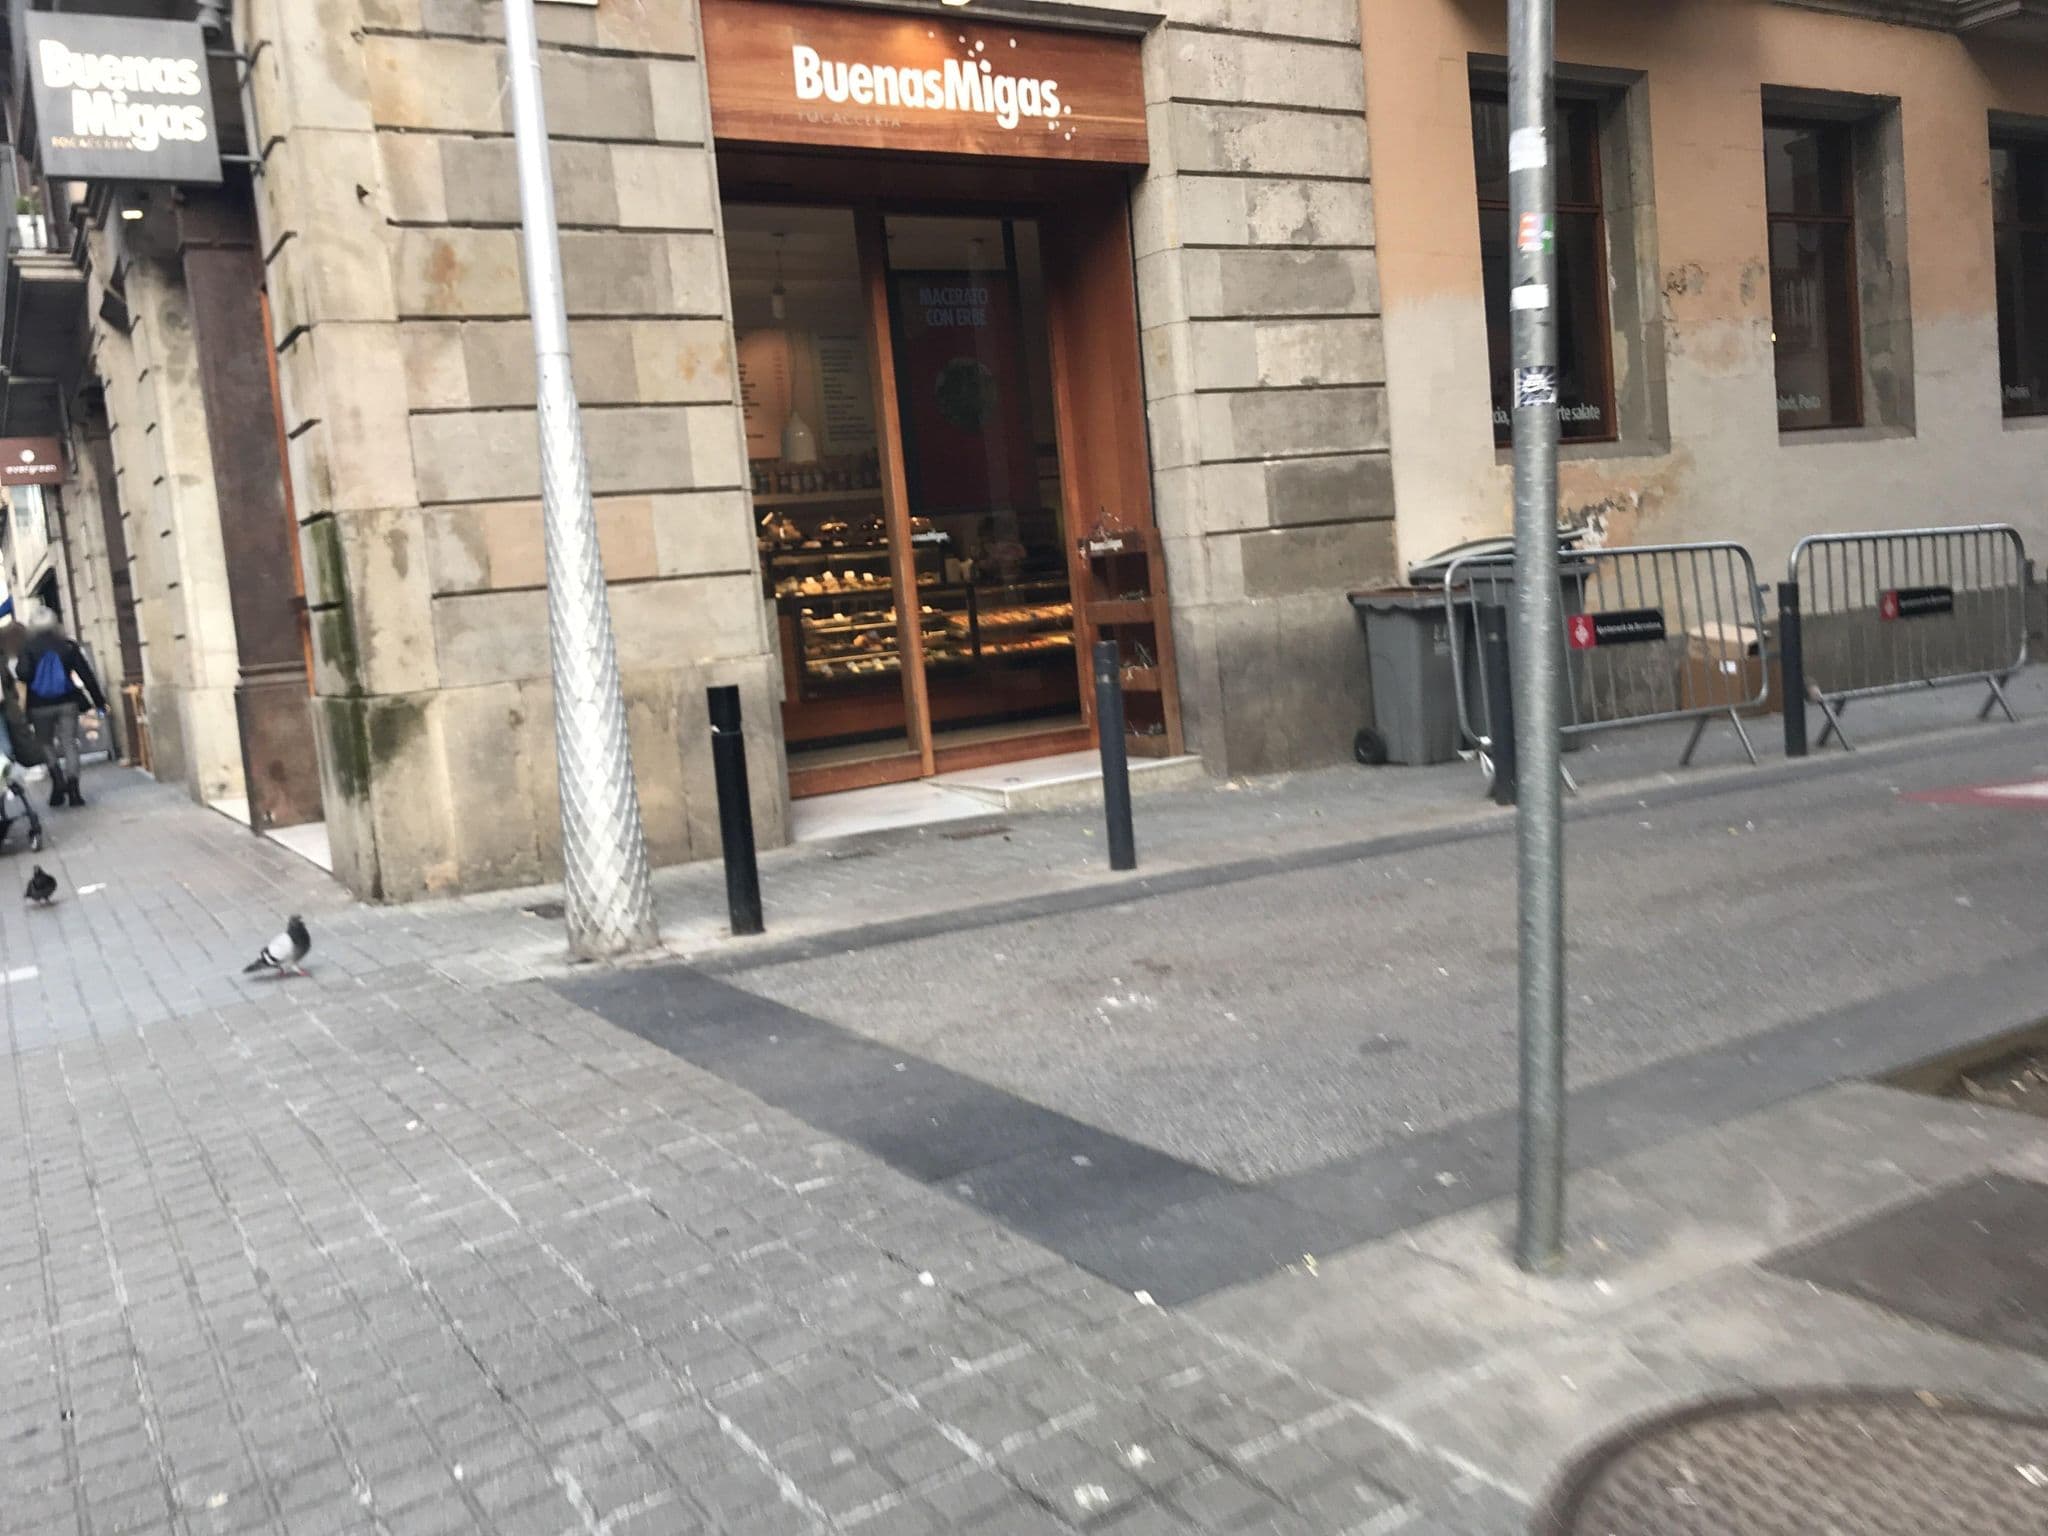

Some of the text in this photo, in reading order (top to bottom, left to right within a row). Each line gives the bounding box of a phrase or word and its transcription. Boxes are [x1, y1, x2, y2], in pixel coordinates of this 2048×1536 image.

[39, 39, 202, 95] Buenas
[71, 89, 207, 151] Migas
[927, 308, 954, 327] CON
